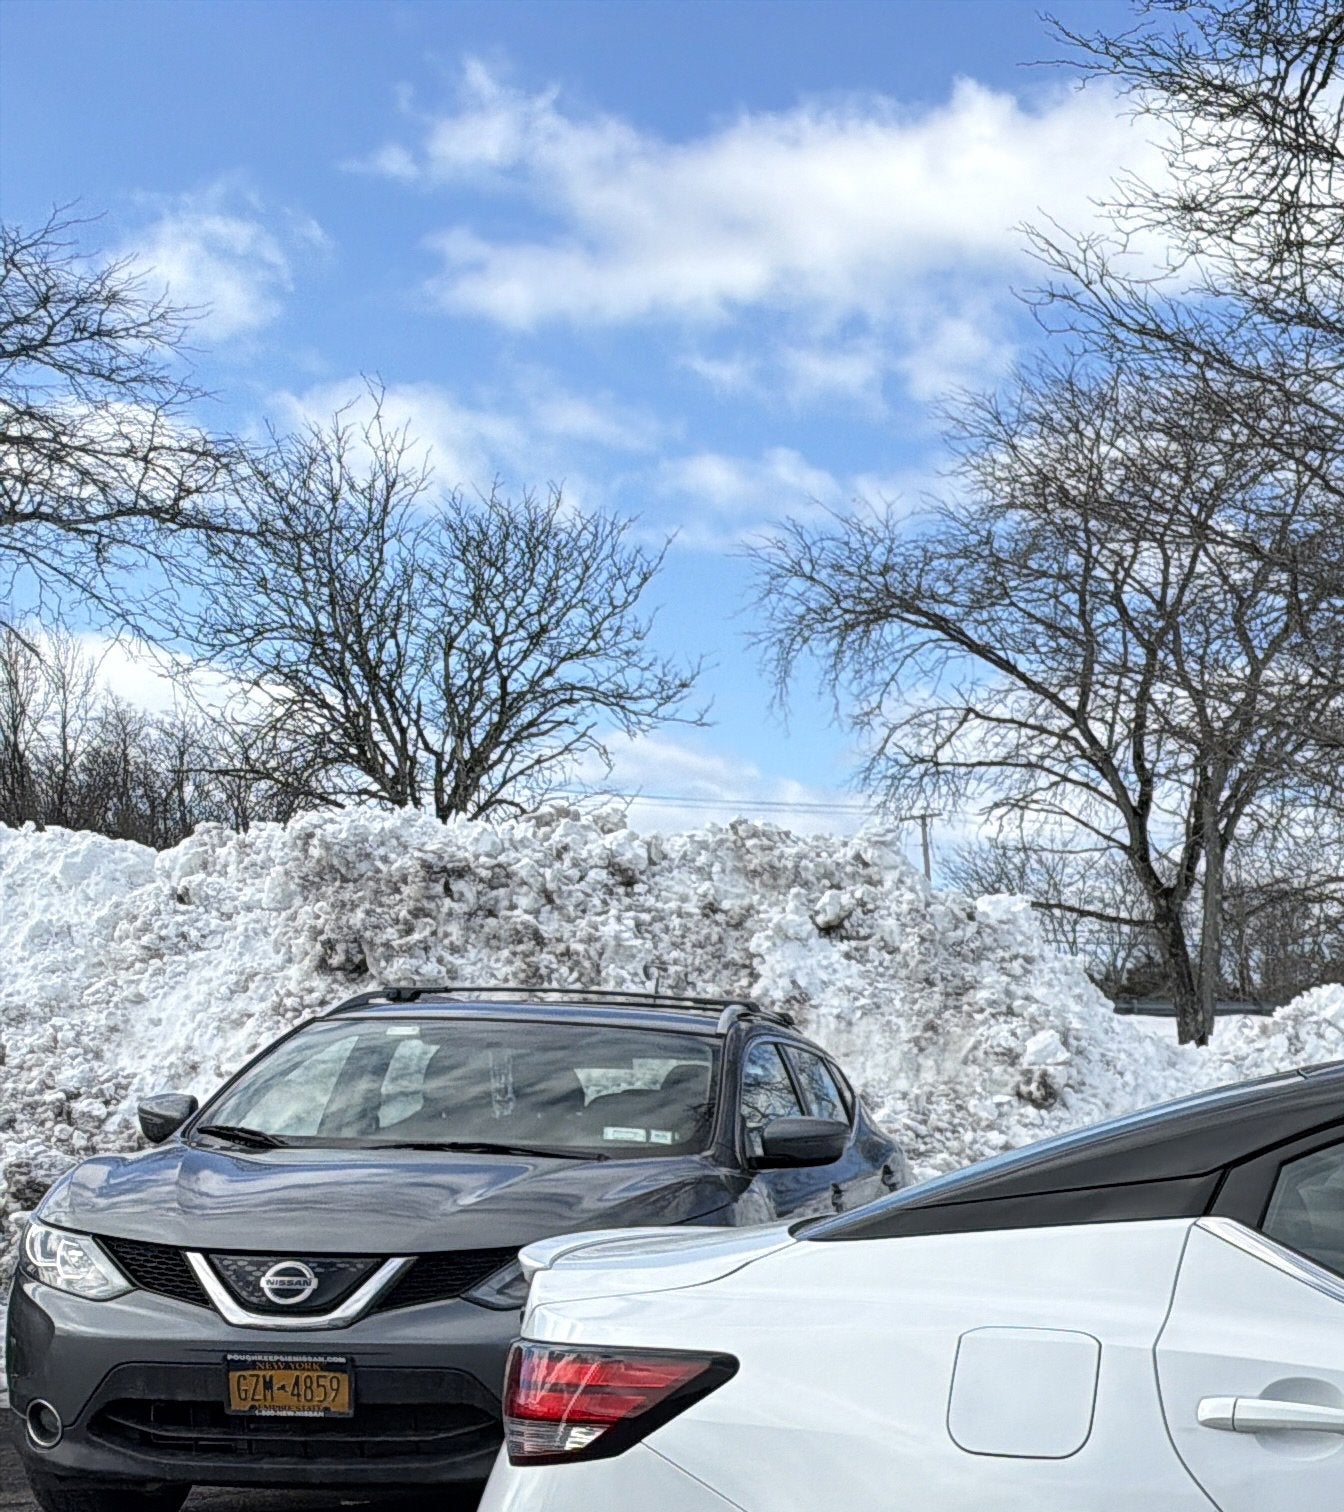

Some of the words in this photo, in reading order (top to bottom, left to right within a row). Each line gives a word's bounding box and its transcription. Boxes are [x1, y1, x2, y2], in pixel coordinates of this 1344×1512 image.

[265, 1279, 313, 1287] NISSAN
[256, 1362, 286, 1371] NEW
[289, 1362, 321, 1371] YORK
[236, 1373, 275, 1402] GZM
[290, 1374, 341, 1403] 4859
